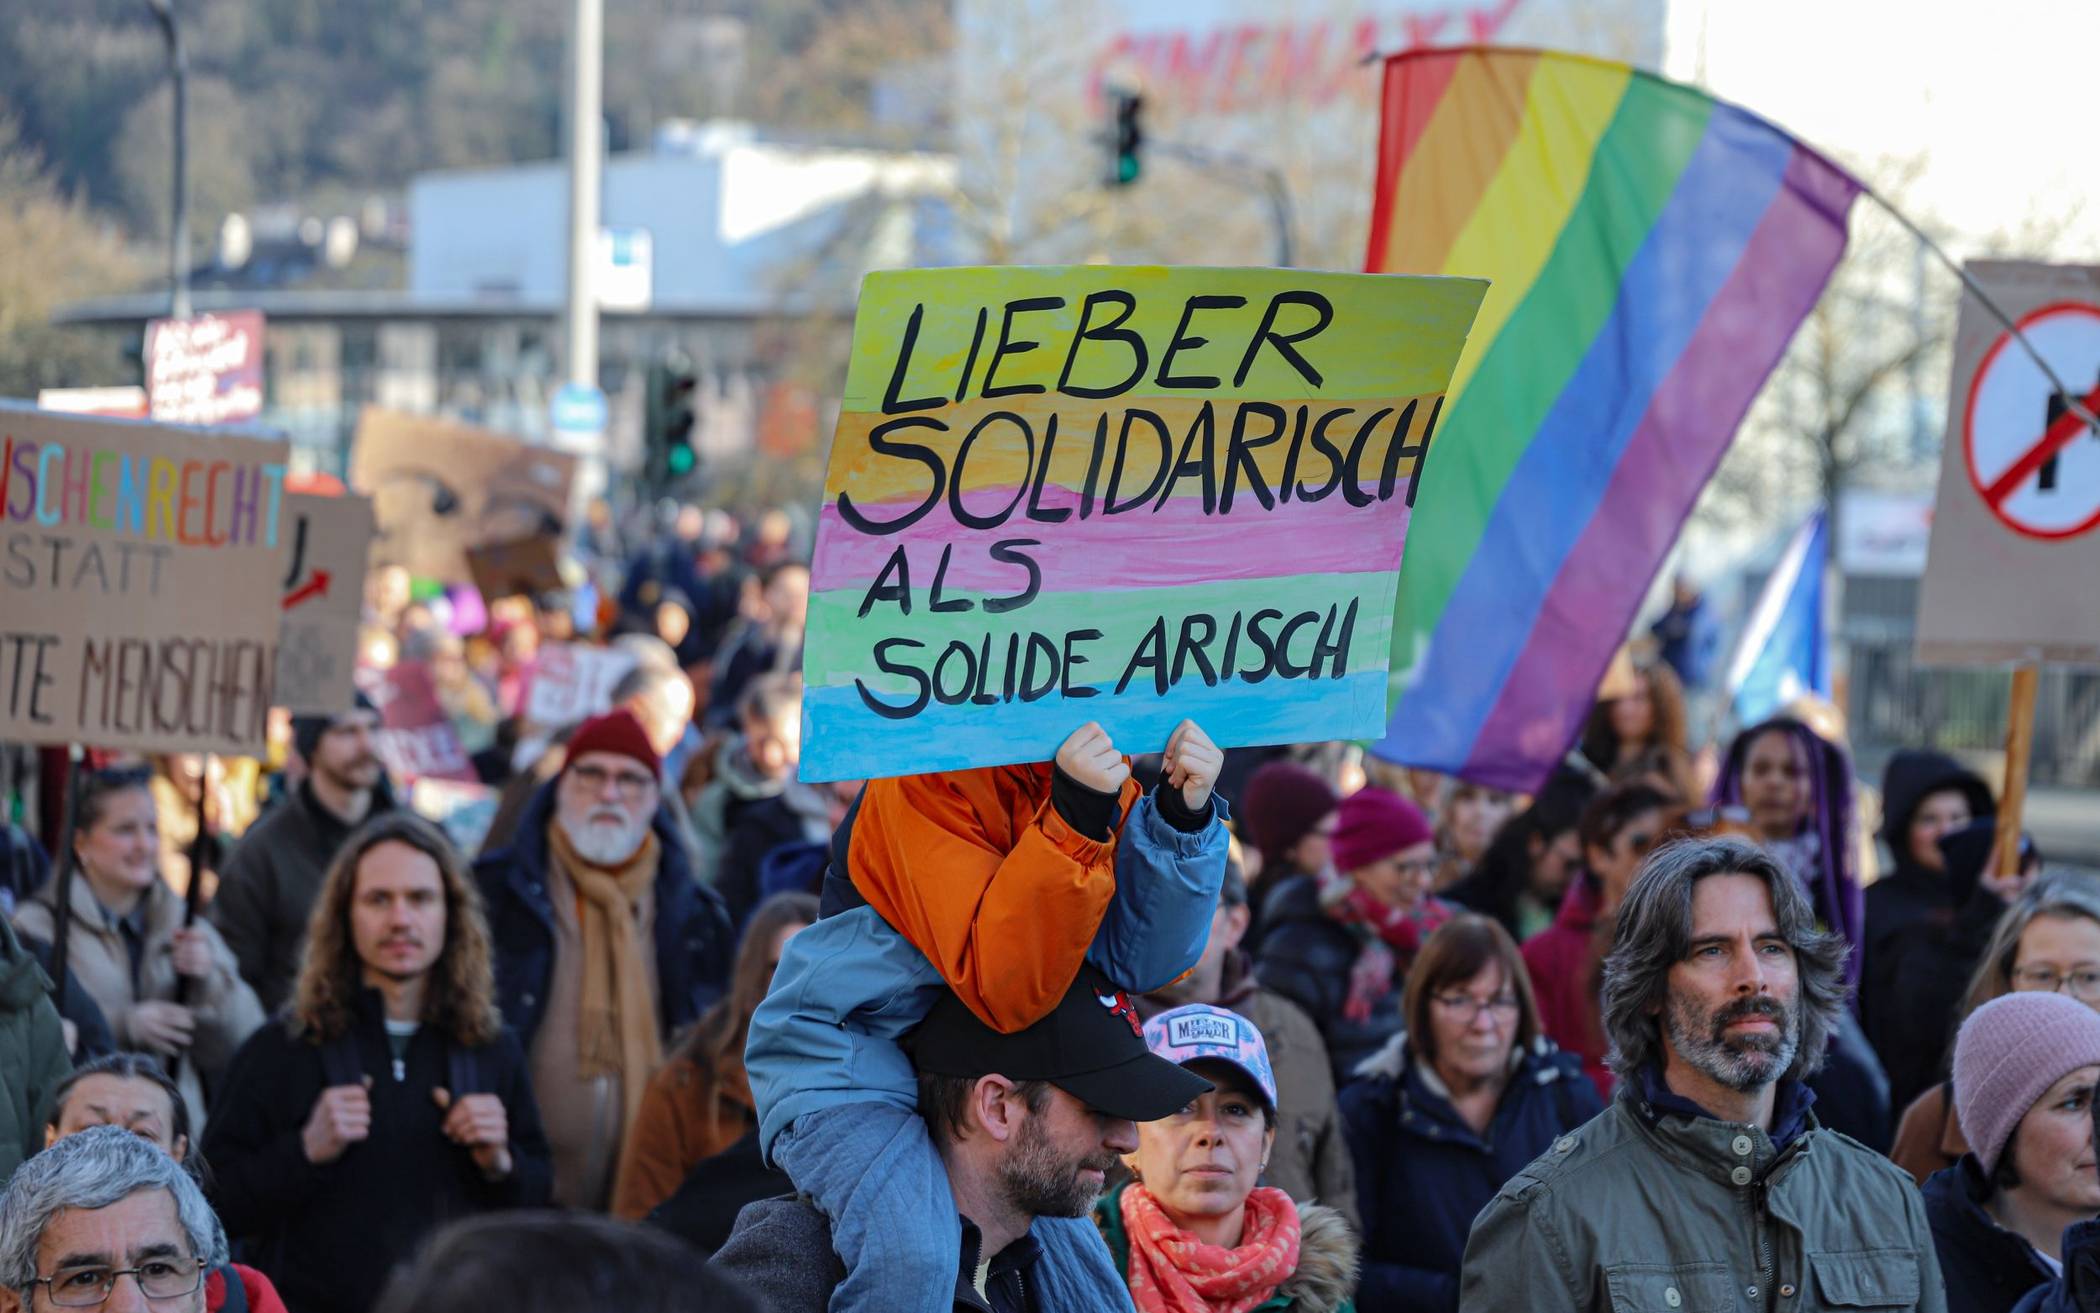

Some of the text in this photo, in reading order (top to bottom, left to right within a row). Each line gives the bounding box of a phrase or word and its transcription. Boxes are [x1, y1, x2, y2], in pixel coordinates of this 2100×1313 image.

[882, 290, 1333, 415] LIEBER
[838, 397, 1444, 535] SOLIDARISCH
[4, 534, 172, 595] STATT
[858, 539, 1040, 617] ALS
[77, 635, 279, 745] MENSCHEN
[855, 596, 1359, 718] SOLIDE ARISCH
